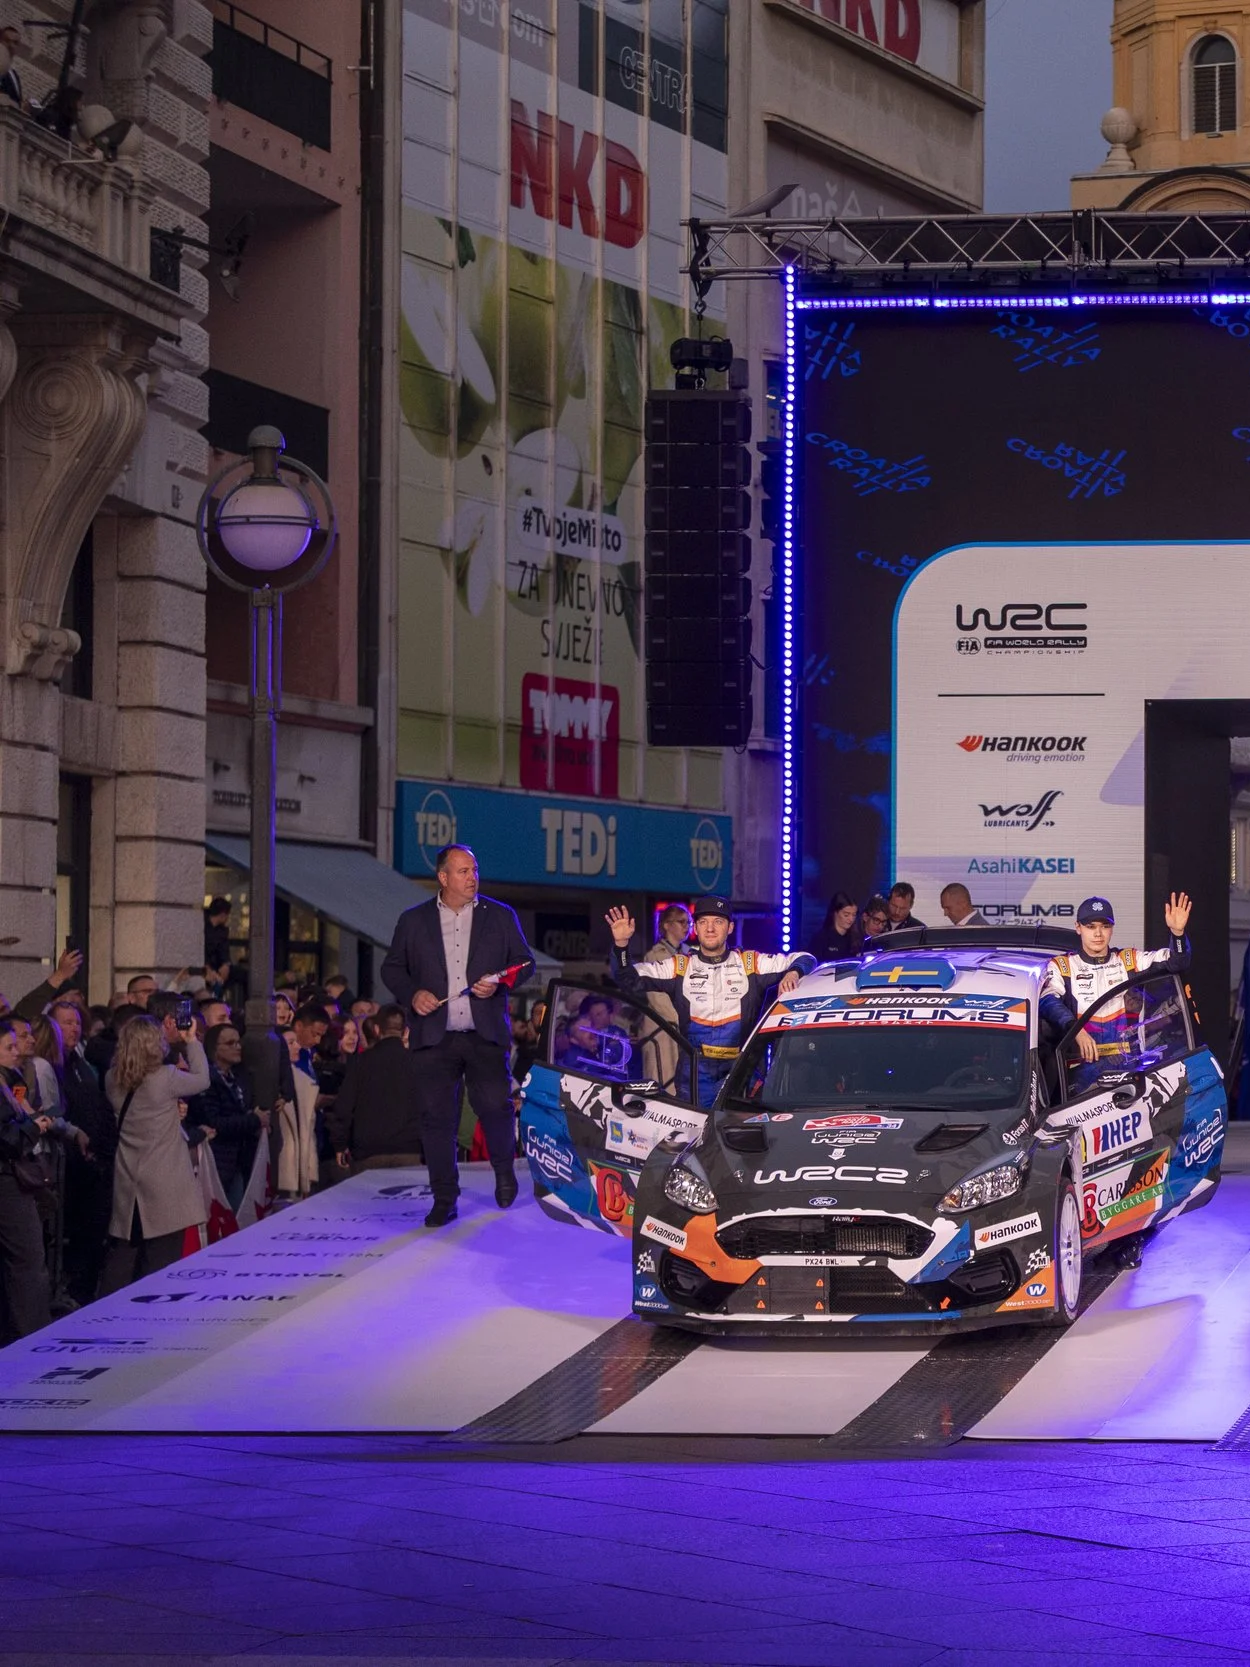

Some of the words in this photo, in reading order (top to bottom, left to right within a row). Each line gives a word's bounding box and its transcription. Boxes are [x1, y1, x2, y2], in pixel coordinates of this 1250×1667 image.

[510, 99, 648, 248] NKD
[517, 560, 541, 602] ZA
[956, 603, 1087, 631] WRC
[1006, 752, 1041, 763] driving
[1043, 753, 1085, 762] emotion
[541, 808, 617, 877] TEDi
[813, 1009, 1010, 1024] FORUM8
[1108, 1111, 1142, 1146] HEP
[1185, 1125, 1225, 1167] WRC
[527, 1142, 573, 1183] WRC
[754, 1165, 909, 1185] WRC2
[1101, 1192, 1148, 1220] BYGGARE
[1151, 1186, 1164, 1197] AB
[194, 1294, 300, 1302] JANAF
[641, 1288, 657, 1298] W
[1027, 1285, 1045, 1296] W
[30, 1345, 93, 1353] OIV
